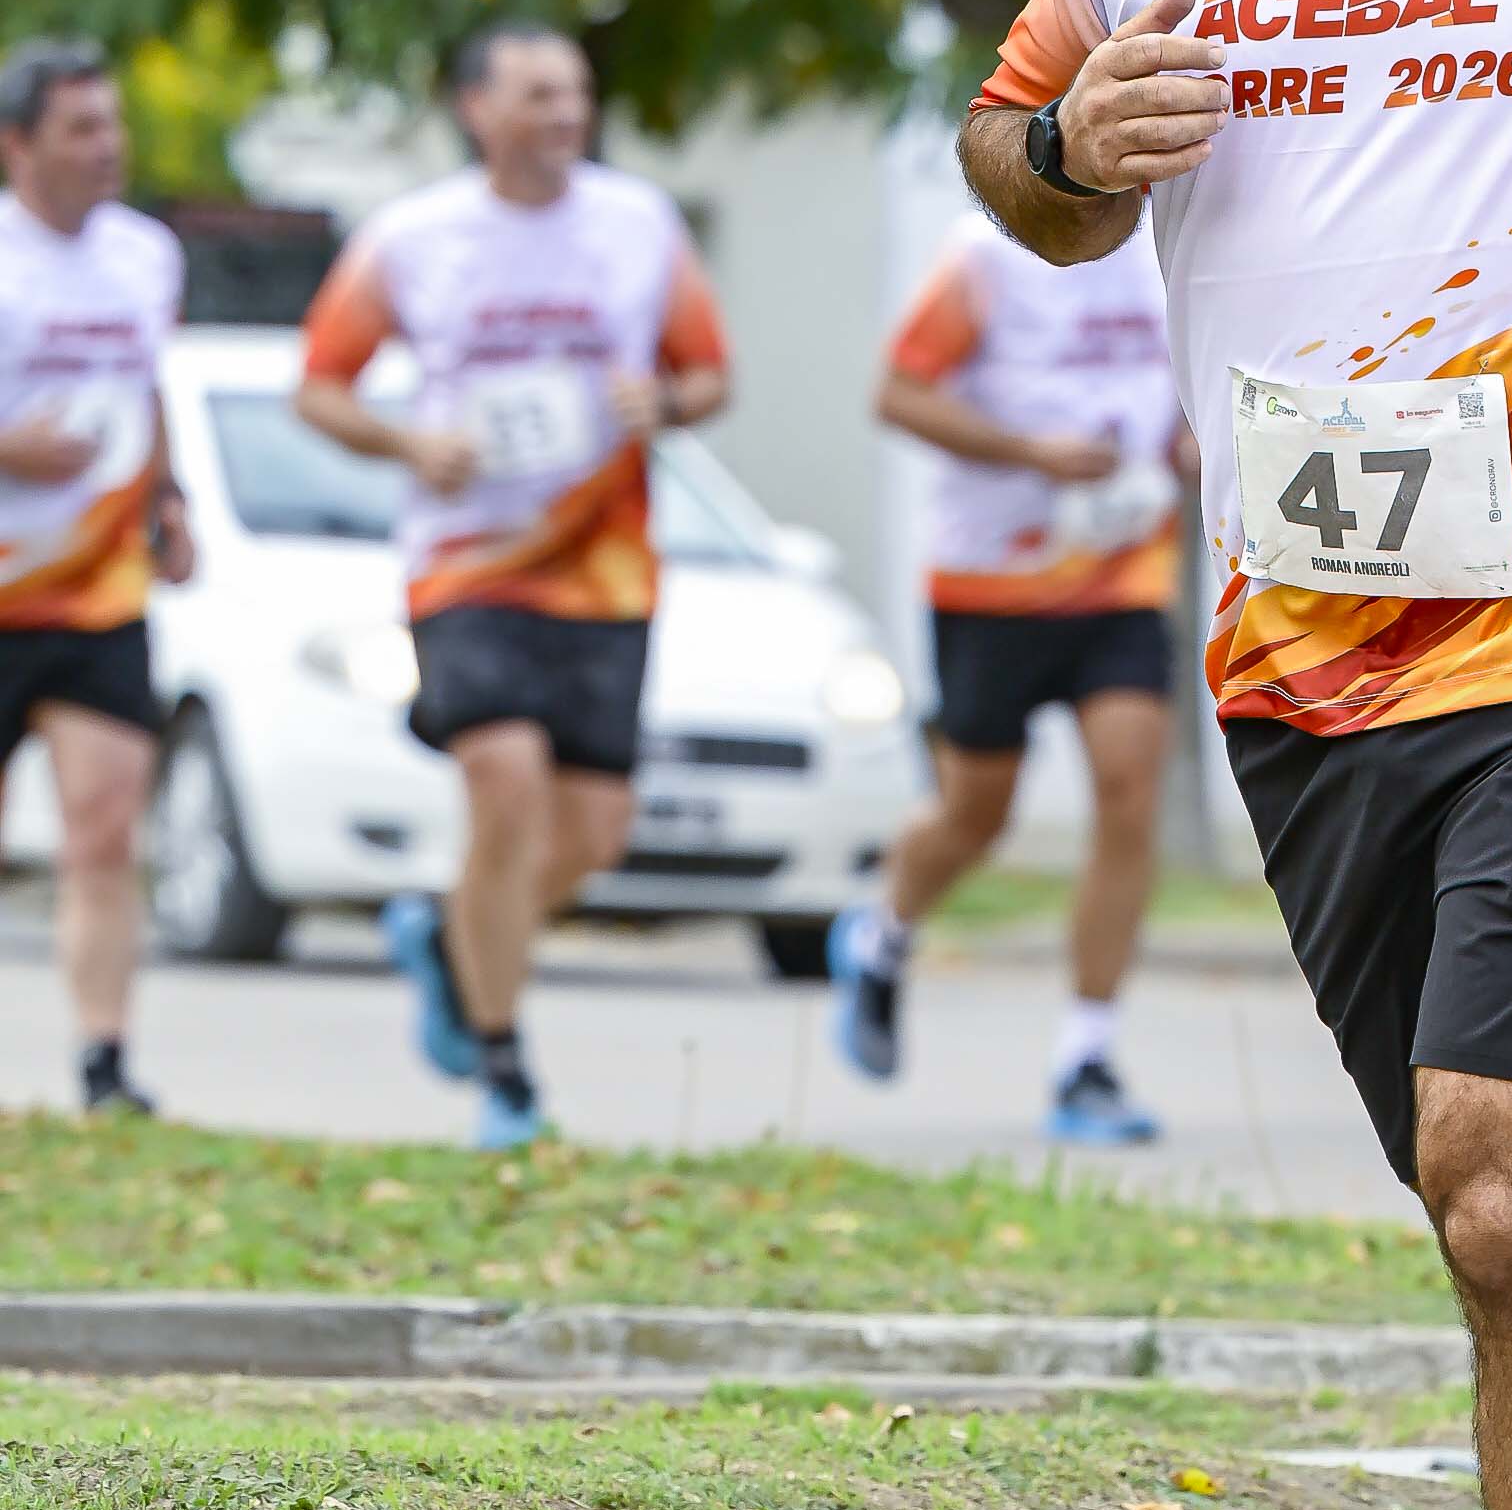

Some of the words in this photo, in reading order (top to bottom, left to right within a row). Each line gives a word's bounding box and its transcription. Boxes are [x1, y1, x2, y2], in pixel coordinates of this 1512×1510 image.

[1203, 64, 1348, 119] RRE
[1277, 448, 1432, 551] 47
[1311, 556, 1352, 574] ROMAN
[1354, 561, 1410, 577] ANDREOLI
